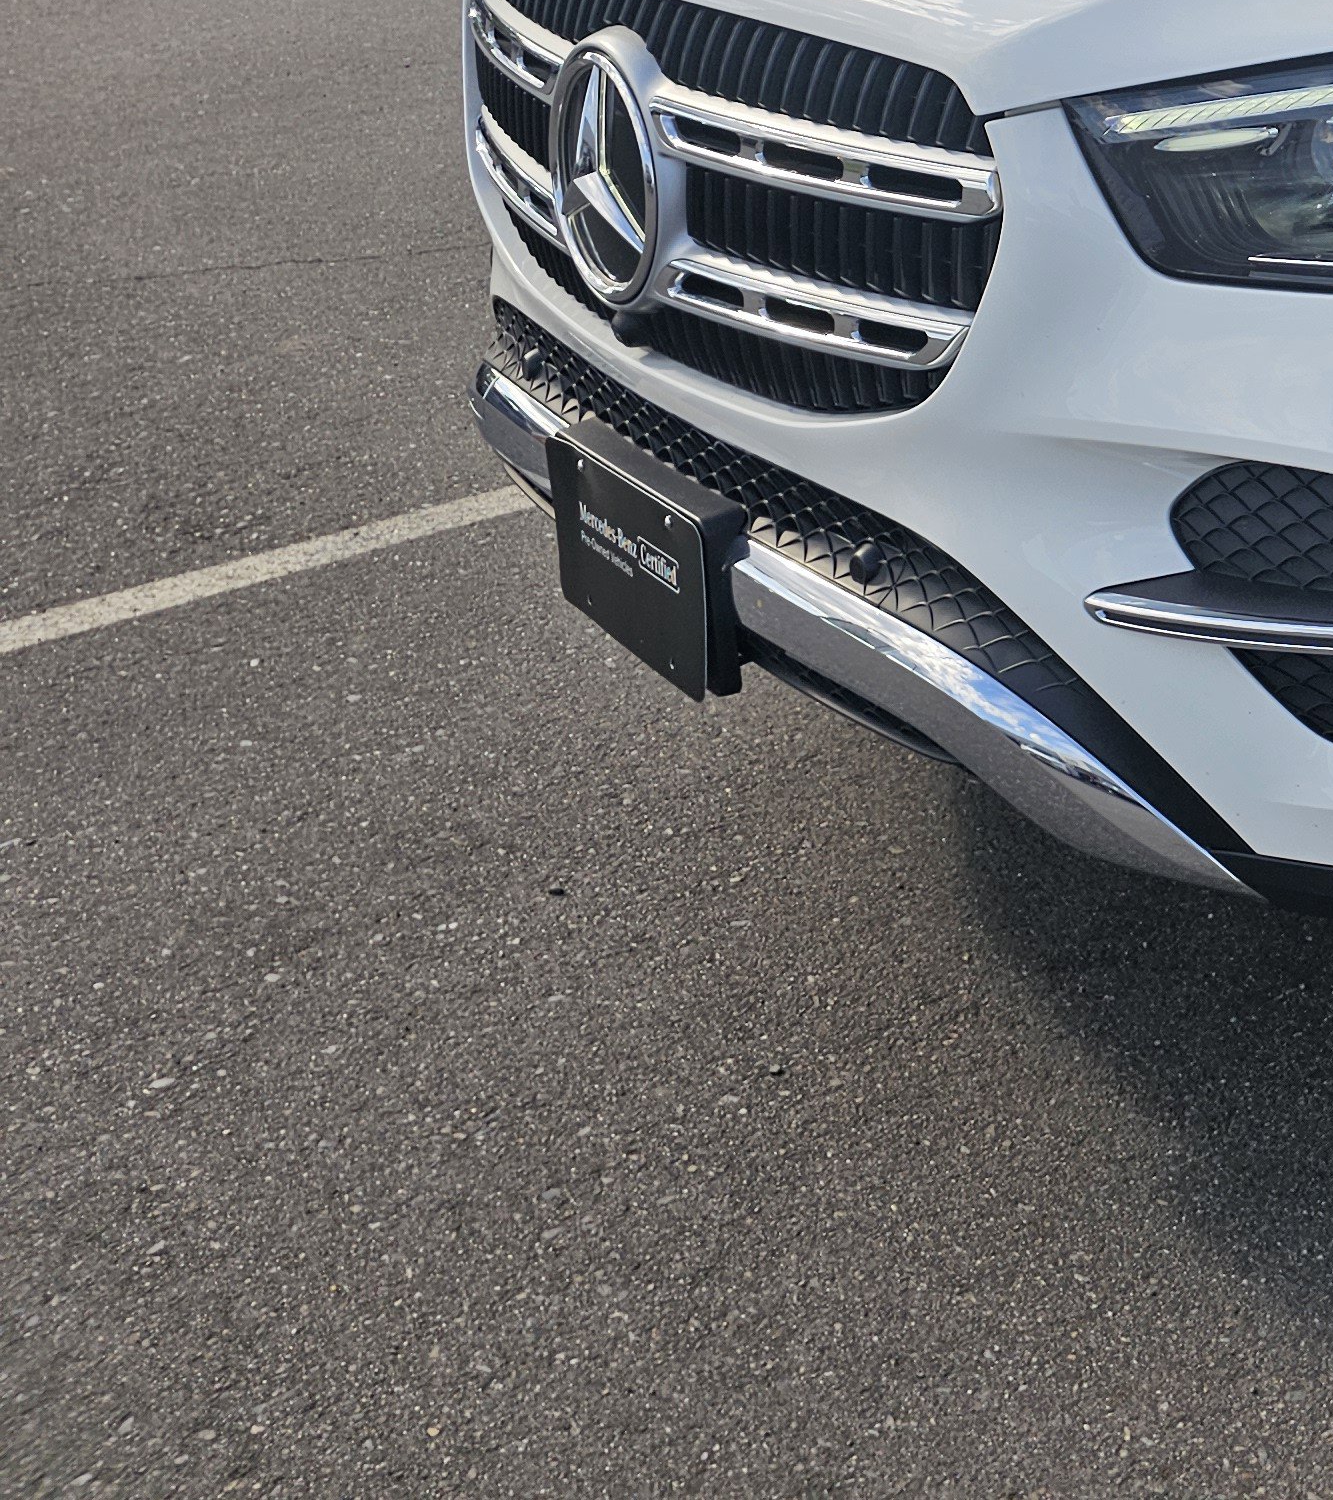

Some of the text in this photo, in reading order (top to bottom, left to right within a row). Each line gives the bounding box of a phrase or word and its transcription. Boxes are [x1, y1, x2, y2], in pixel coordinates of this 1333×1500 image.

[578, 499, 677, 587] Mercedes-Benz Certified
[580, 528, 635, 578] Pre-Owned Vehicles
